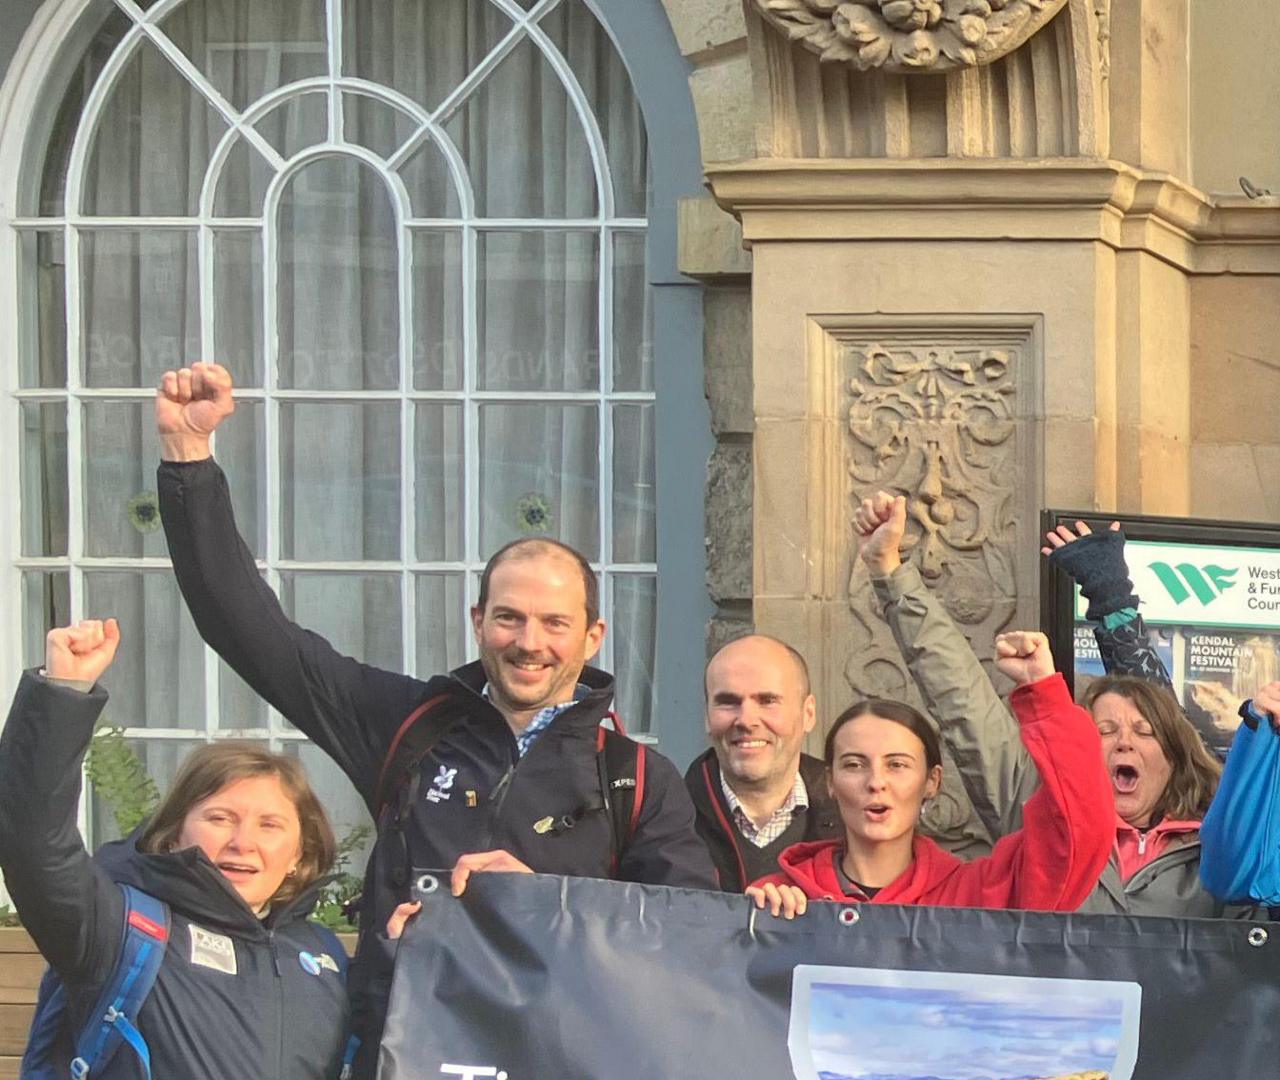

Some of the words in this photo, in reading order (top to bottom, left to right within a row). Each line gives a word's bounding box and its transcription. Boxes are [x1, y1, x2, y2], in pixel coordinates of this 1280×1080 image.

[1247, 582, 1257, 594] &
[1191, 635, 1235, 647] KENDAL
[1191, 645, 1253, 657] MOUNTAIN
[1191, 655, 1238, 668] FESTIVAL
